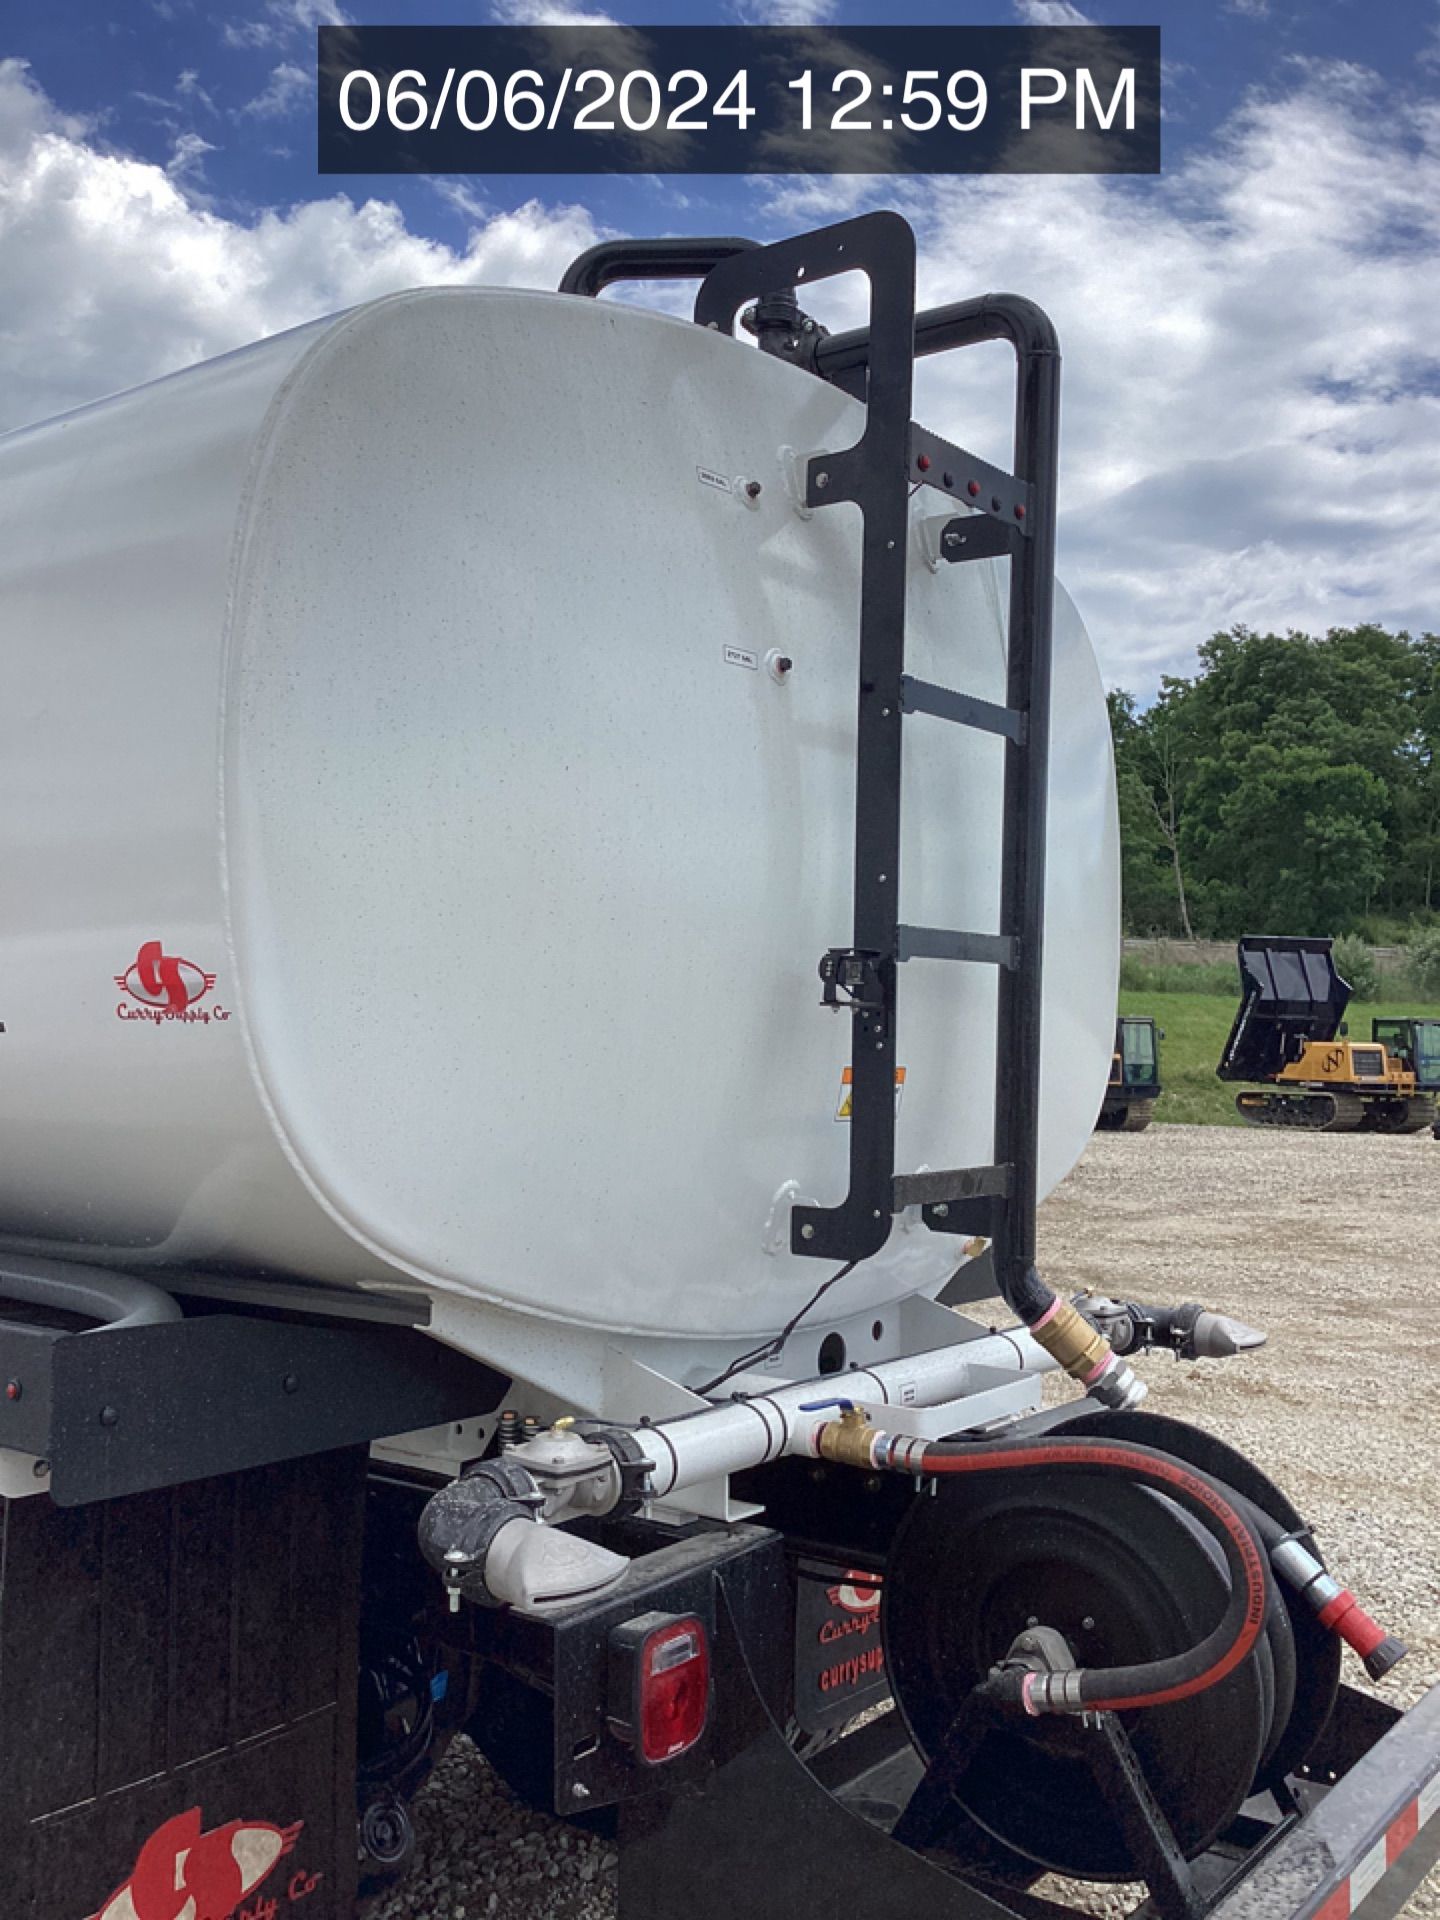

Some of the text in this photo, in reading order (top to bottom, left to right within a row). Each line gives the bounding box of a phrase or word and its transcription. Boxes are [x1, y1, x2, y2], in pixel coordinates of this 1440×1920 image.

[117, 1002, 163, 1024] Curry
[214, 1005, 232, 1021] Co
[1181, 1477, 1231, 1518] CHOICE
[1233, 1525, 1263, 1625] INDUSTRIAL
[819, 1615, 869, 1643] Curry
[288, 1870, 324, 1900] Co
